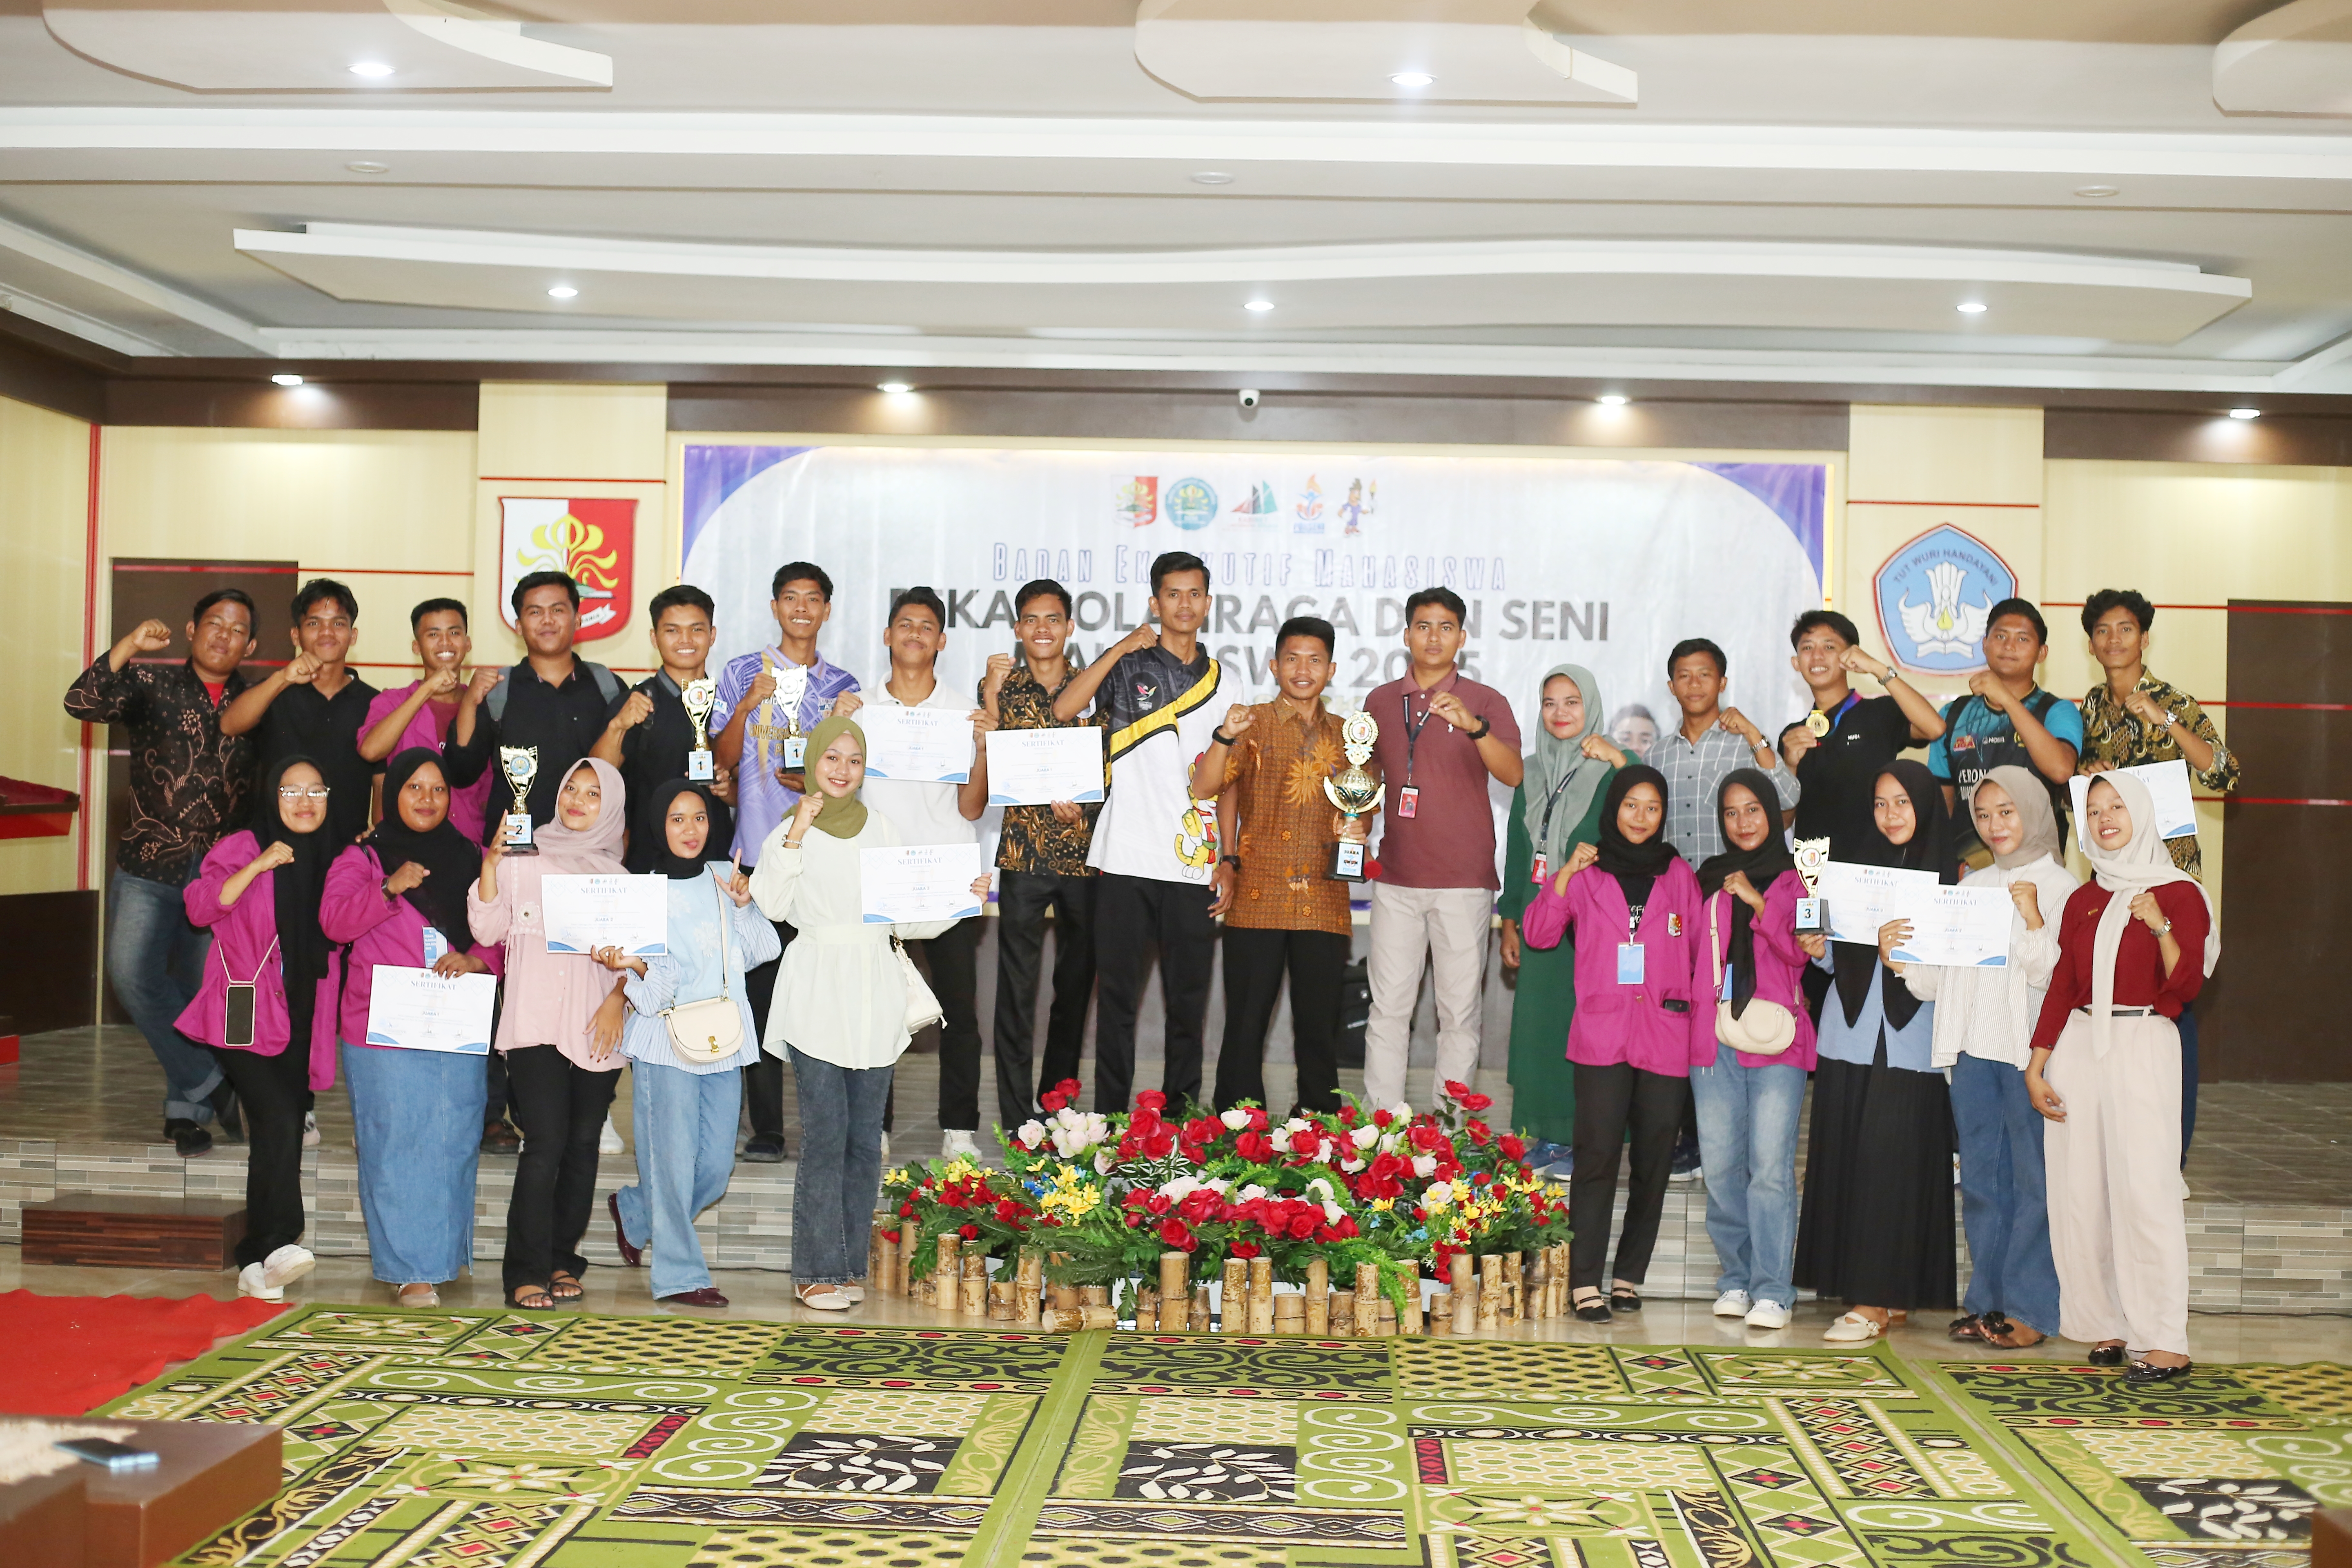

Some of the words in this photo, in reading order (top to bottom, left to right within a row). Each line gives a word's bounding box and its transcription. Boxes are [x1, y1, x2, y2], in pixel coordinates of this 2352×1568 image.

[993, 542, 1091, 582] BADAN
[1116, 545, 1292, 586] EKKUTIF
[1315, 549, 1505, 590] MAHASISWA
[1893, 564, 1911, 584] TUT
[1912, 550, 1940, 567] WURI
[1943, 548, 1998, 586] HANDAYANI
[1072, 591, 1360, 636] OLRAGA
[1499, 599, 1608, 641] SENI
[1350, 648, 1482, 687] 205
[793, 748, 798, 758] 1
[697, 761, 702, 771] 1
[516, 825, 523, 835] 2
[898, 857, 942, 865] SERTIFIKAT
[1934, 898, 1977, 906] SERTIFIKAT
[1805, 909, 1811, 919] 3
[410, 980, 457, 991] SERTIFIKAT
